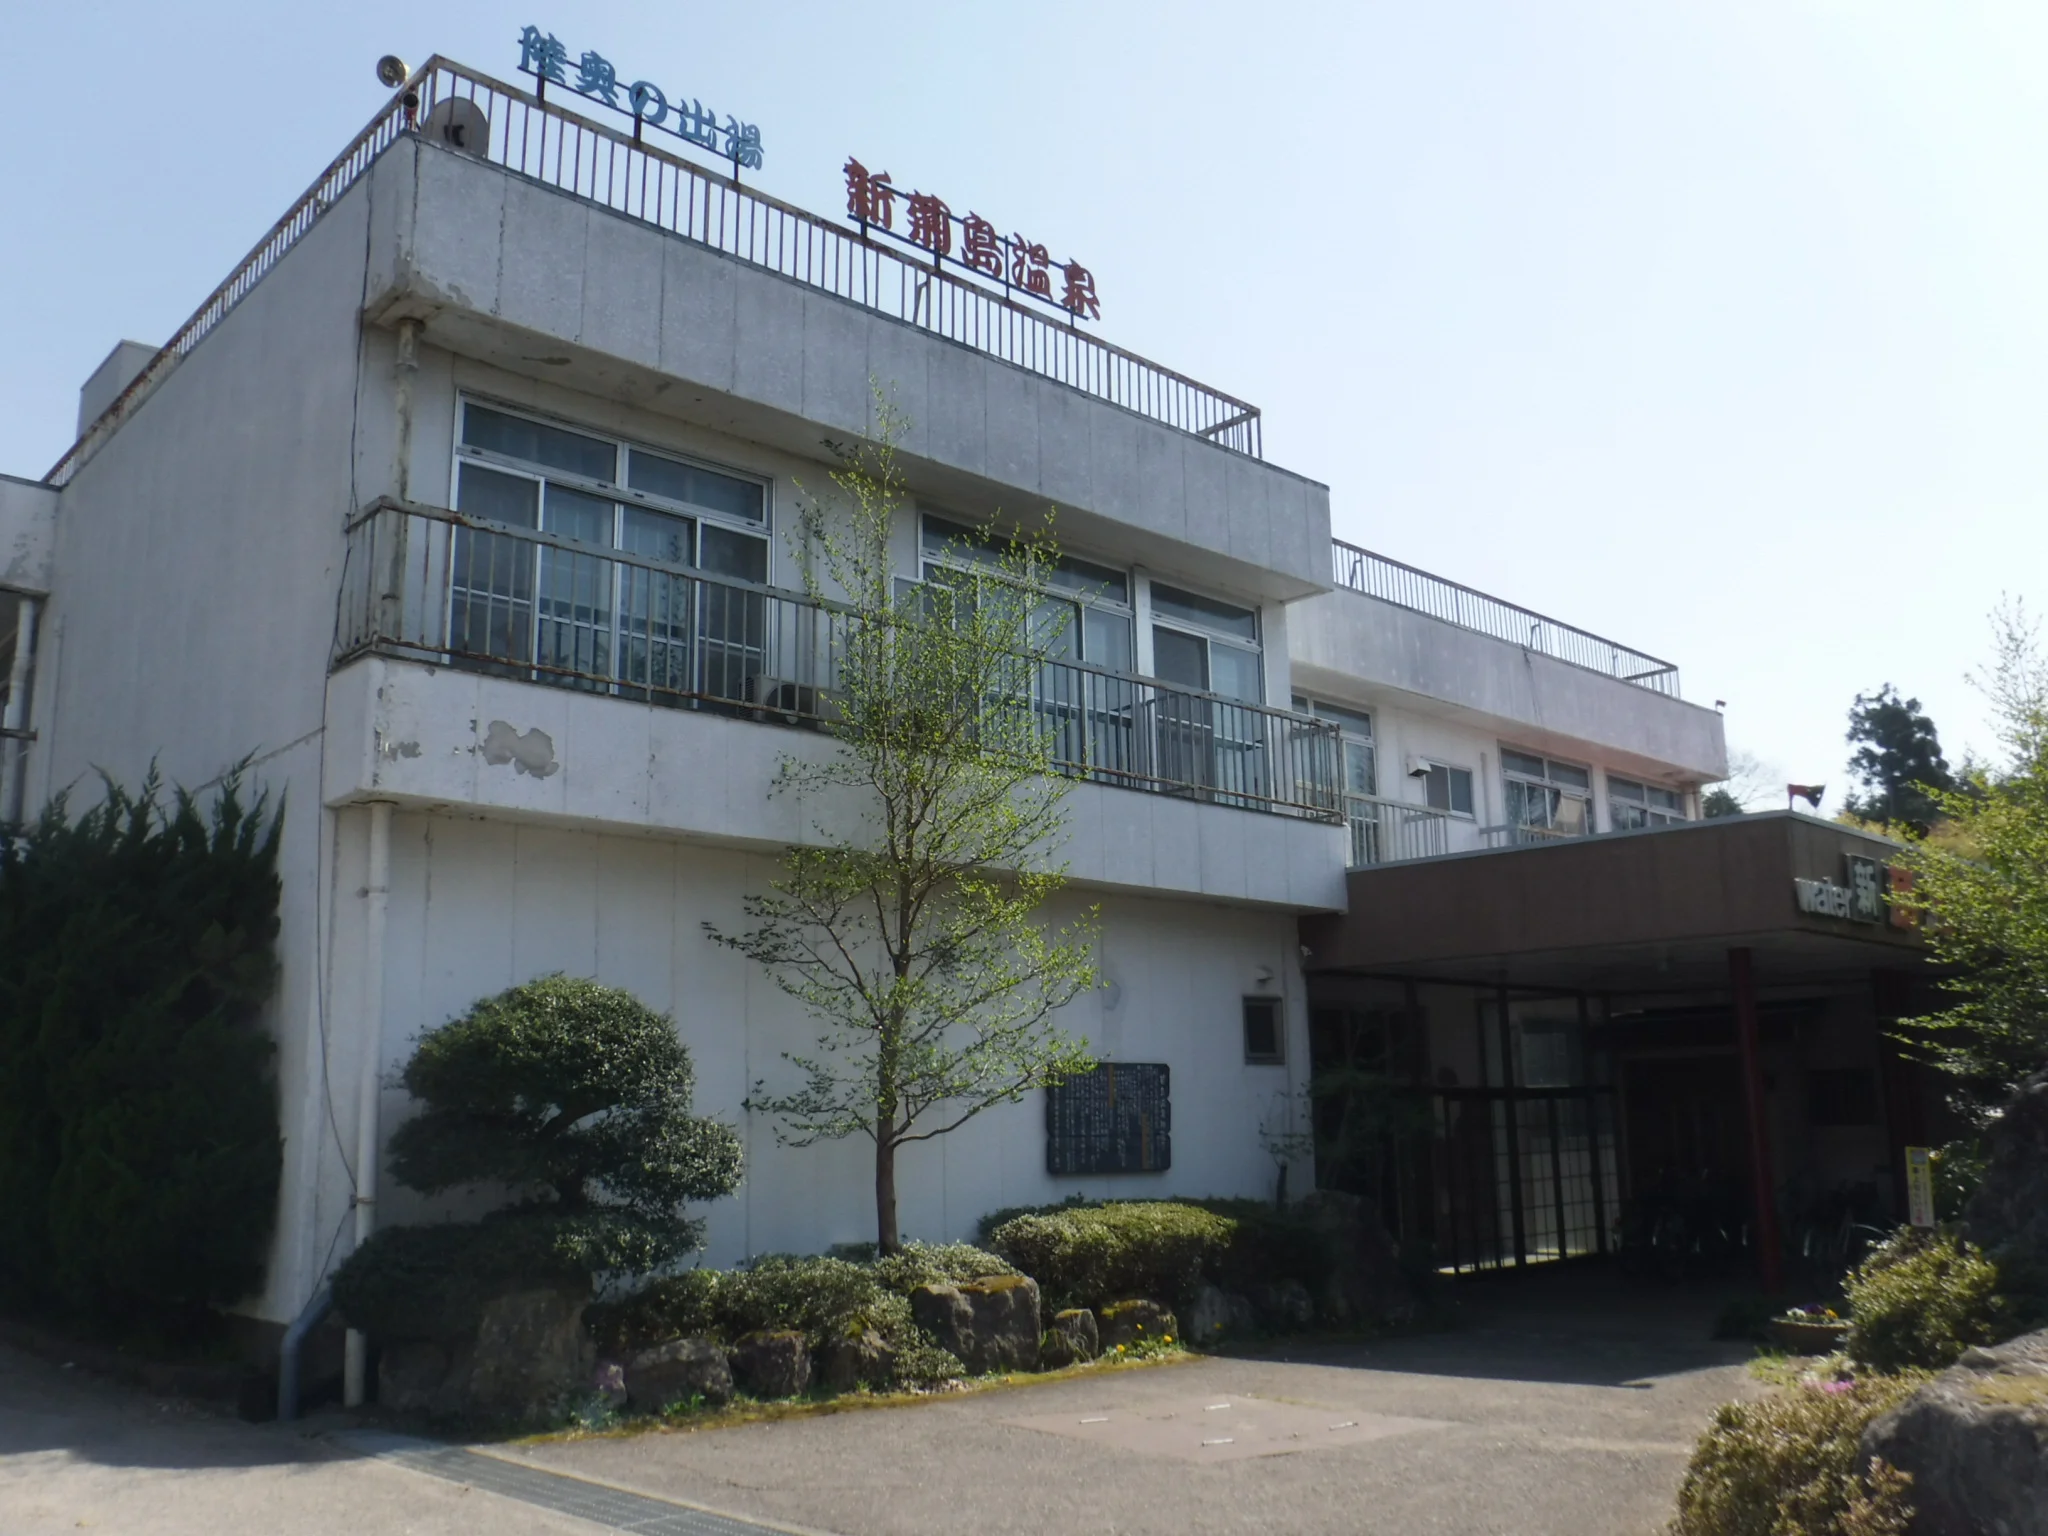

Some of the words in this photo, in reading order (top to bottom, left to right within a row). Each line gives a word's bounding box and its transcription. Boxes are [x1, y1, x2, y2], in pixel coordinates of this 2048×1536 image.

[520, 24, 764, 171] 陸奥の出湯
